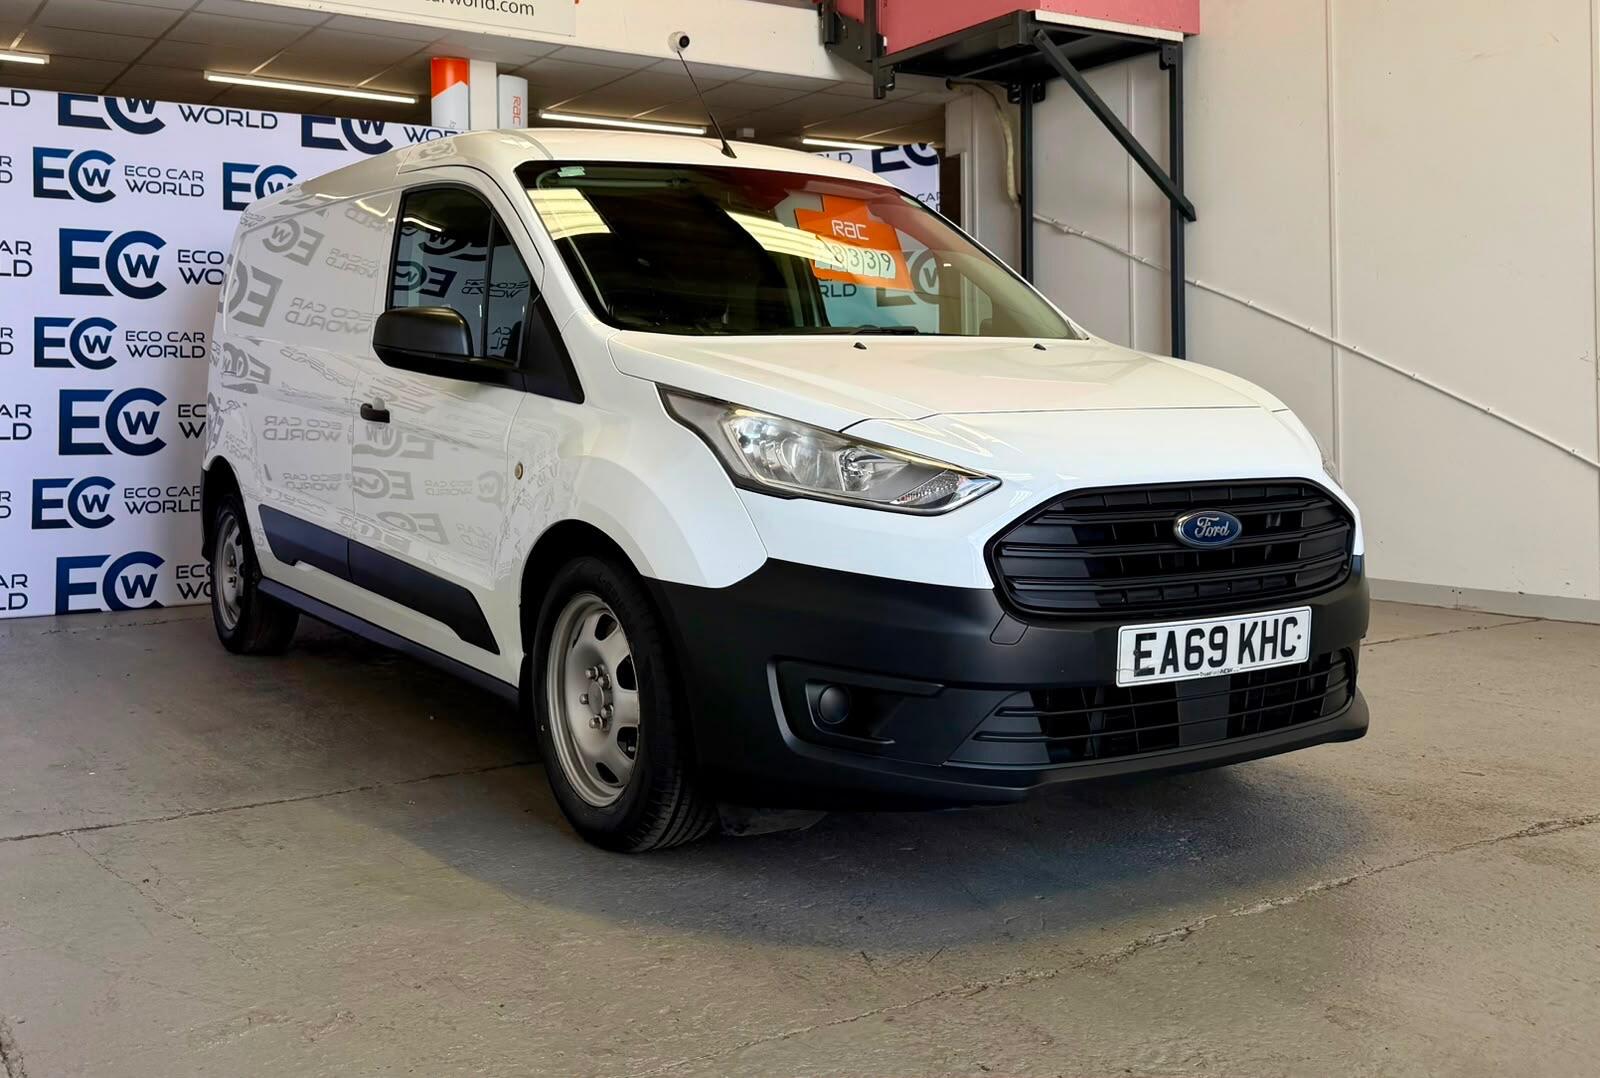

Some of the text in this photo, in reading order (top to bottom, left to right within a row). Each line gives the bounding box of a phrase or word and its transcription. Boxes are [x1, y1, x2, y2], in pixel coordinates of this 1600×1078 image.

[178, 104, 278, 129] WORLD
[33, 147, 116, 203] ECW
[124, 165, 204, 181] ECO CAR
[125, 179, 204, 197] WORLD
[0, 240, 32, 254] AR
[59, 227, 167, 299] ECW
[178, 249, 224, 264] ECO
[34, 317, 117, 370] ECW
[125, 331, 205, 343] ECO CAR
[126, 344, 206, 358] WORLD
[0, 404, 32, 418] AR
[177, 404, 207, 418] EC
[59, 388, 167, 456] ECW
[124, 487, 161, 498] ECO
[32, 476, 115, 529] ECW
[1194, 516, 1230, 538] Ford
[1133, 616, 1299, 677] EA69 KHC
